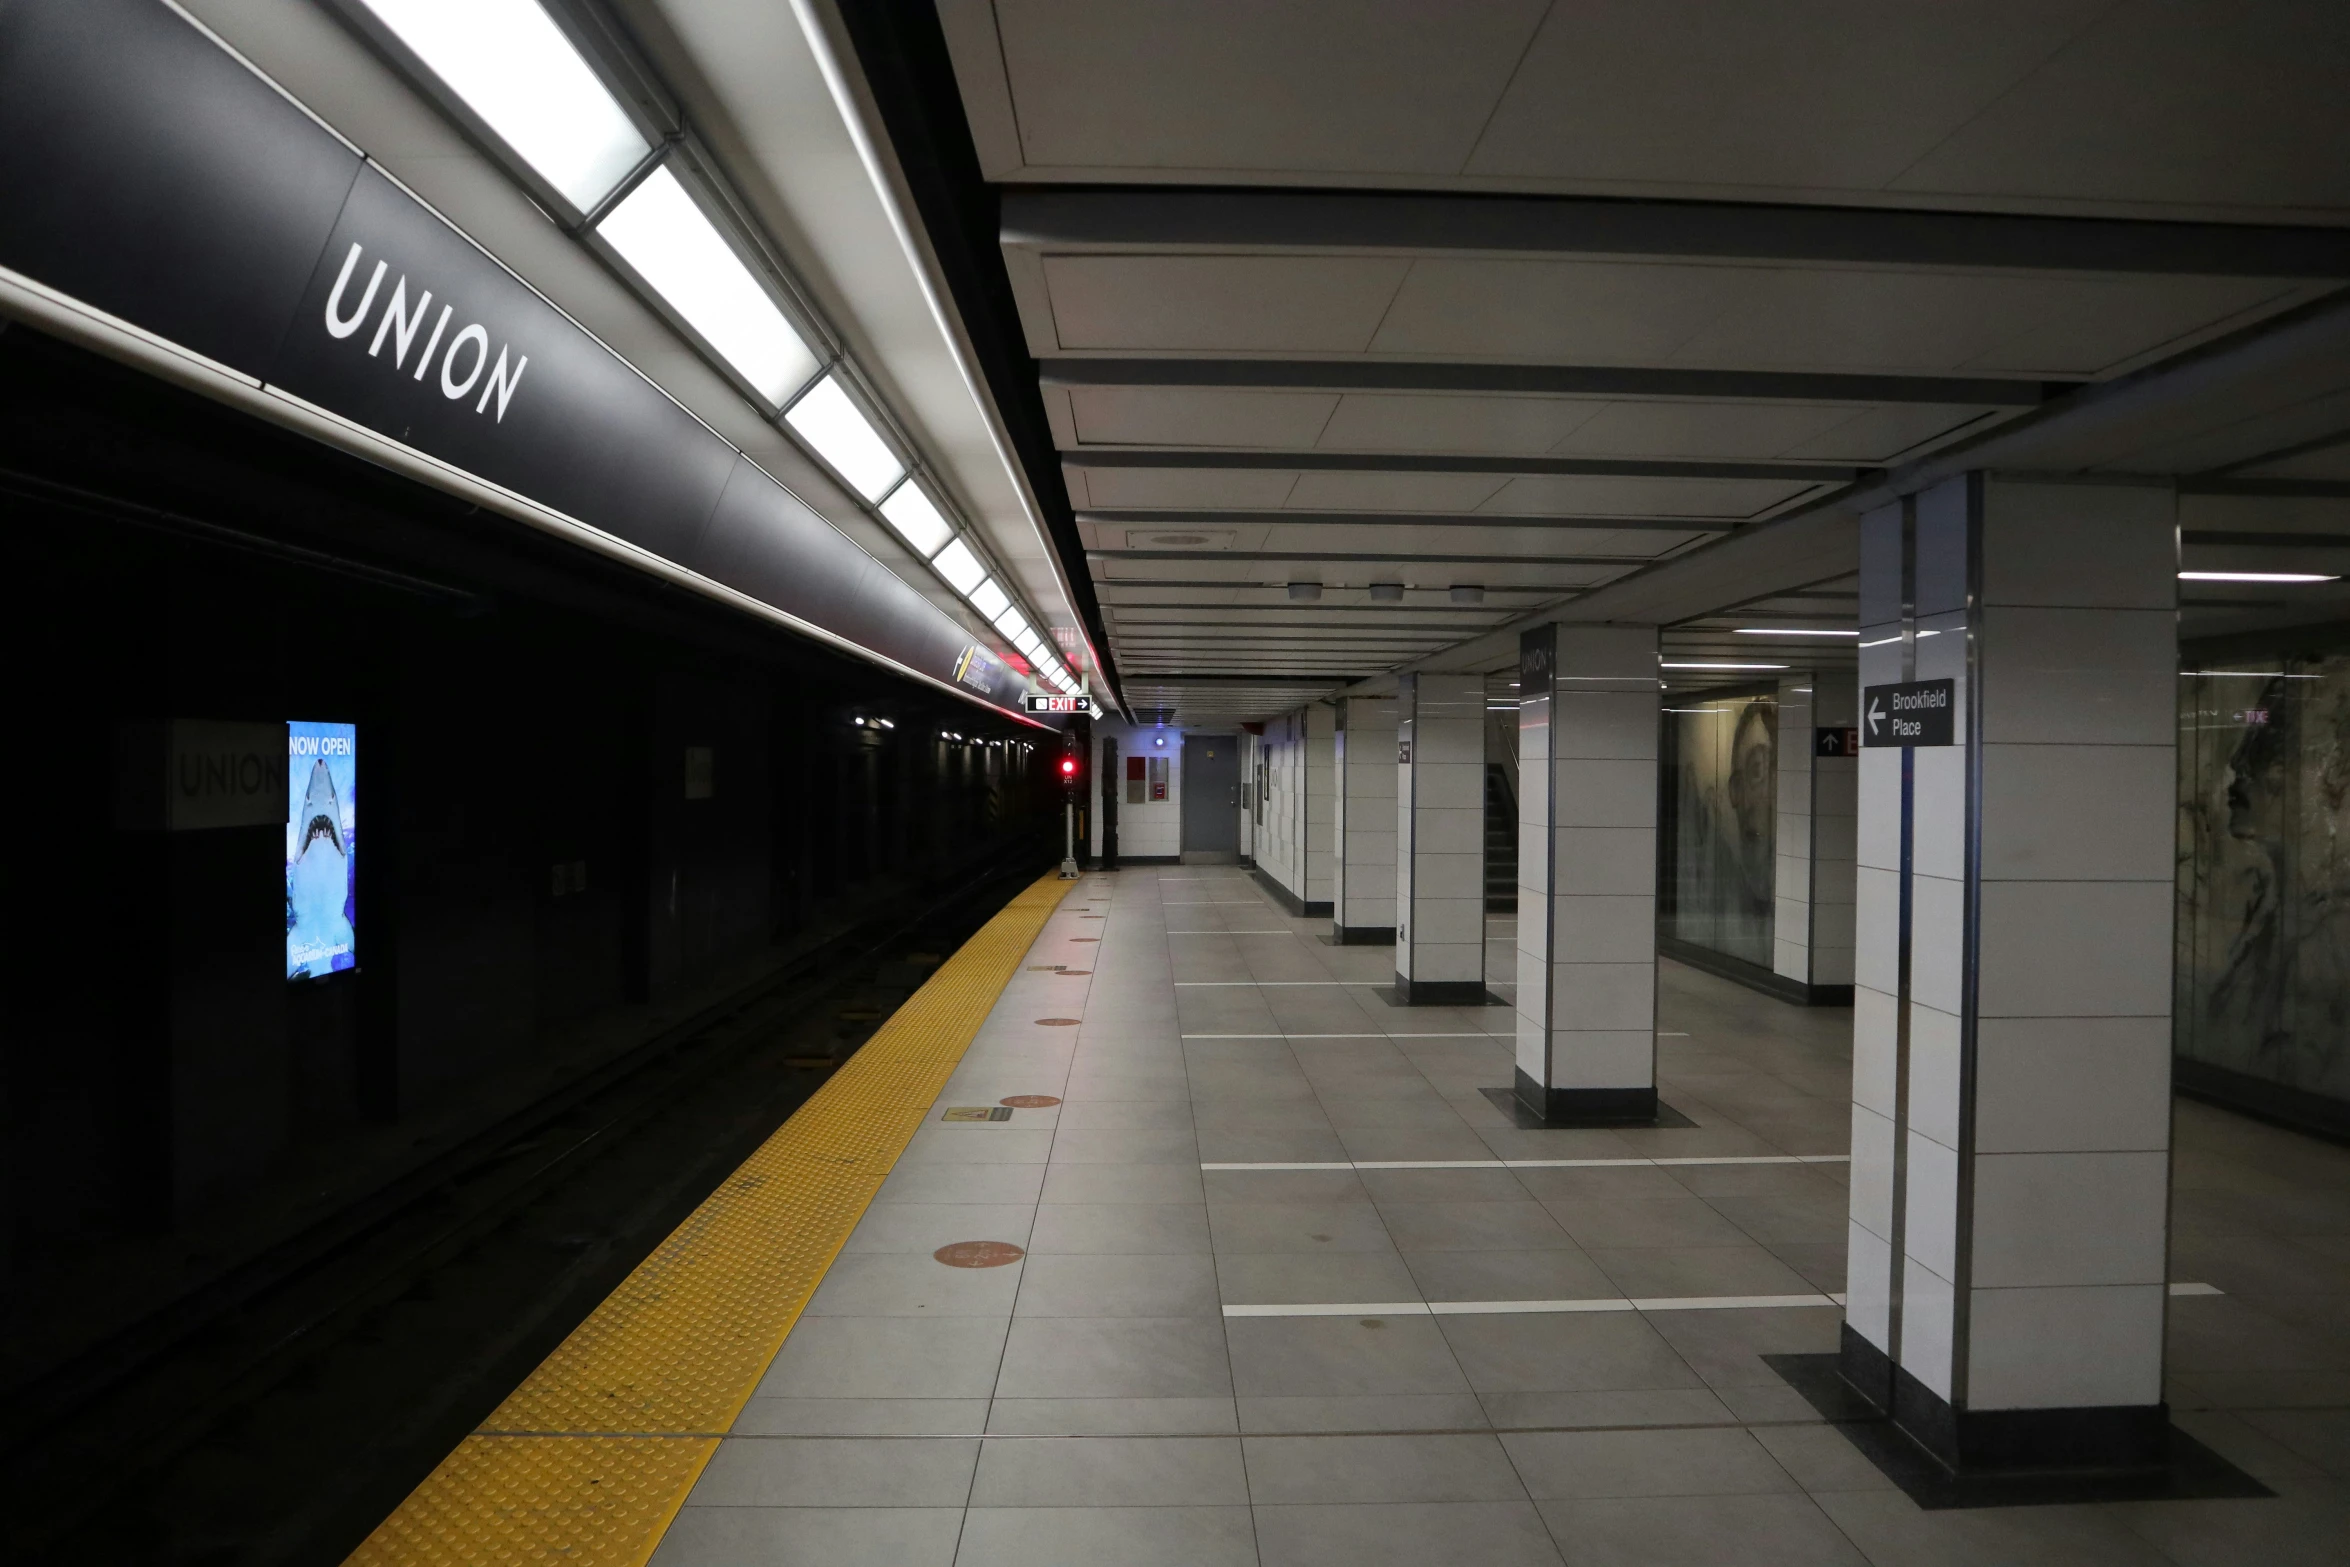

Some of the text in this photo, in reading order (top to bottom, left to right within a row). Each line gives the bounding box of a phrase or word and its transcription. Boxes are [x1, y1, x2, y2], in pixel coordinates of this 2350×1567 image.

[325, 242, 528, 424] UNION
[1522, 645, 1547, 675] UNION
[1048, 697, 1076, 711] EXIT
[1892, 688, 1947, 711] Brookfield
[1892, 718, 1922, 736] Place
[288, 736, 351, 756] NOW OPEN
[179, 752, 282, 798] UNION
